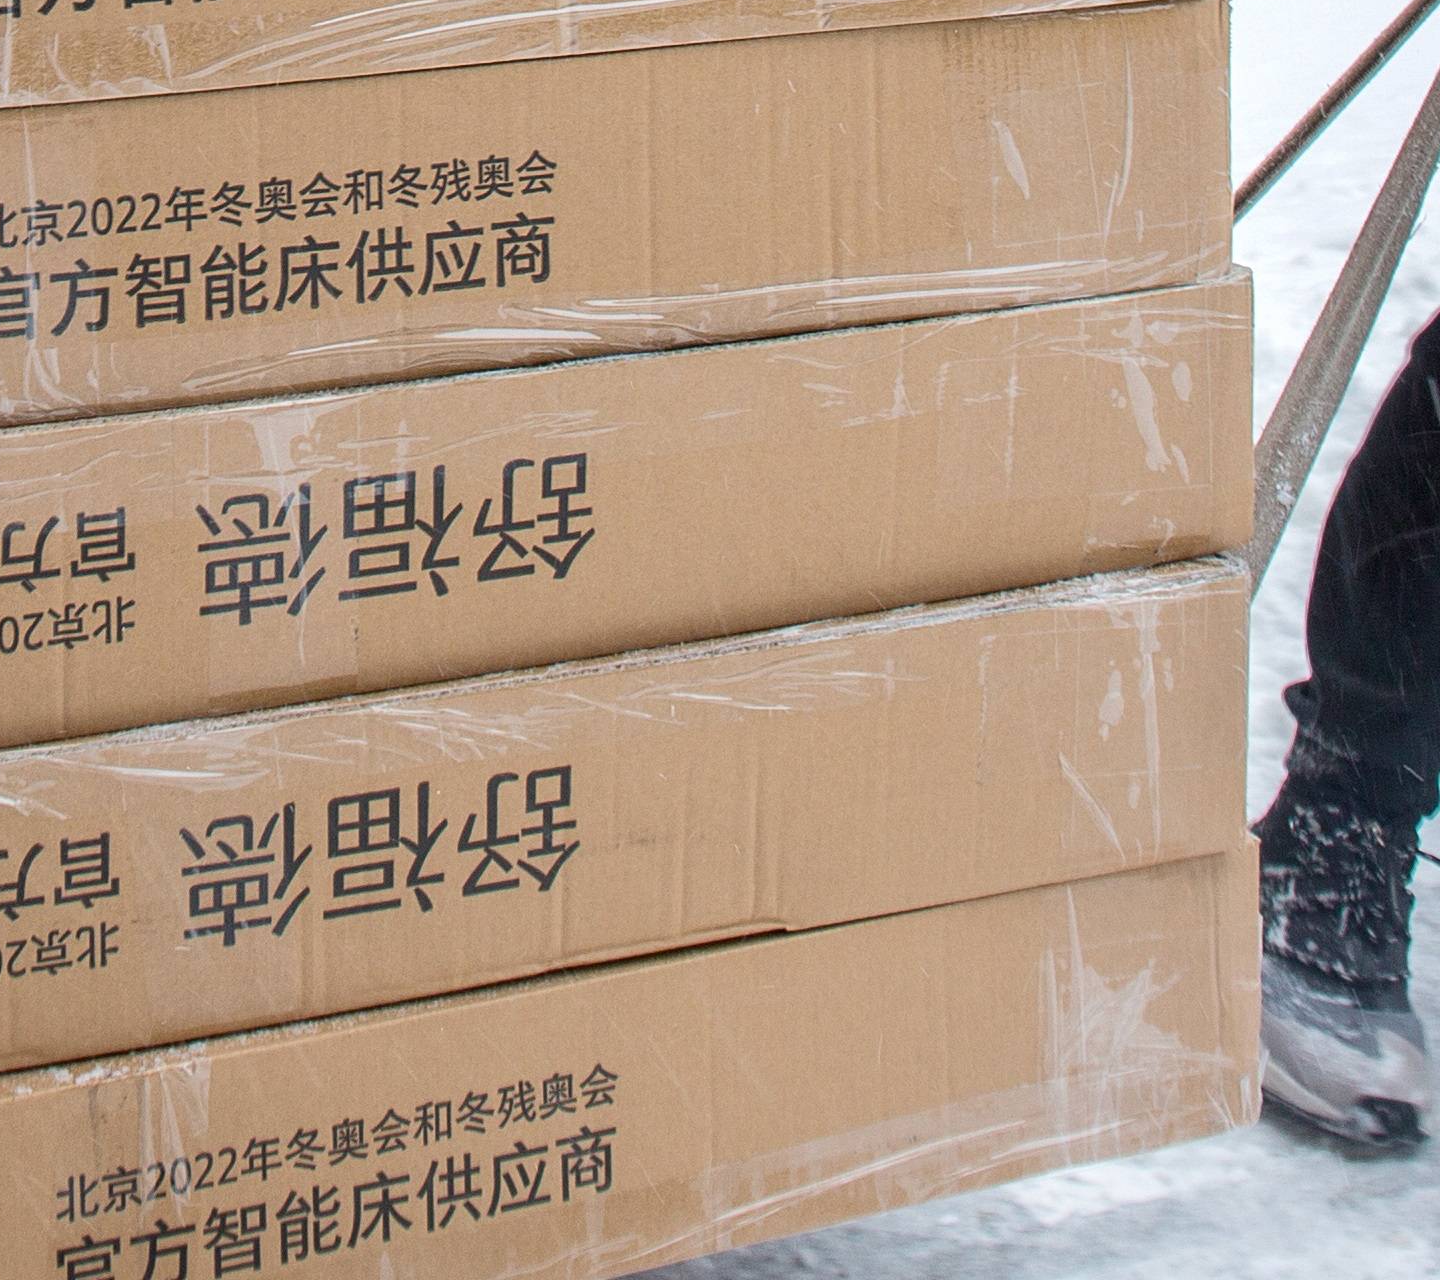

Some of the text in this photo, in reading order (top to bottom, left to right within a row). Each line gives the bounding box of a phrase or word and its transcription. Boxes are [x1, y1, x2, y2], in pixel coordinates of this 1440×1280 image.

[195, 452, 595, 626] 舒福德
[178, 765, 580, 947] 舒福德
[55, 1063, 618, 1223] 北京2022年冬奥会和冬残奥会
